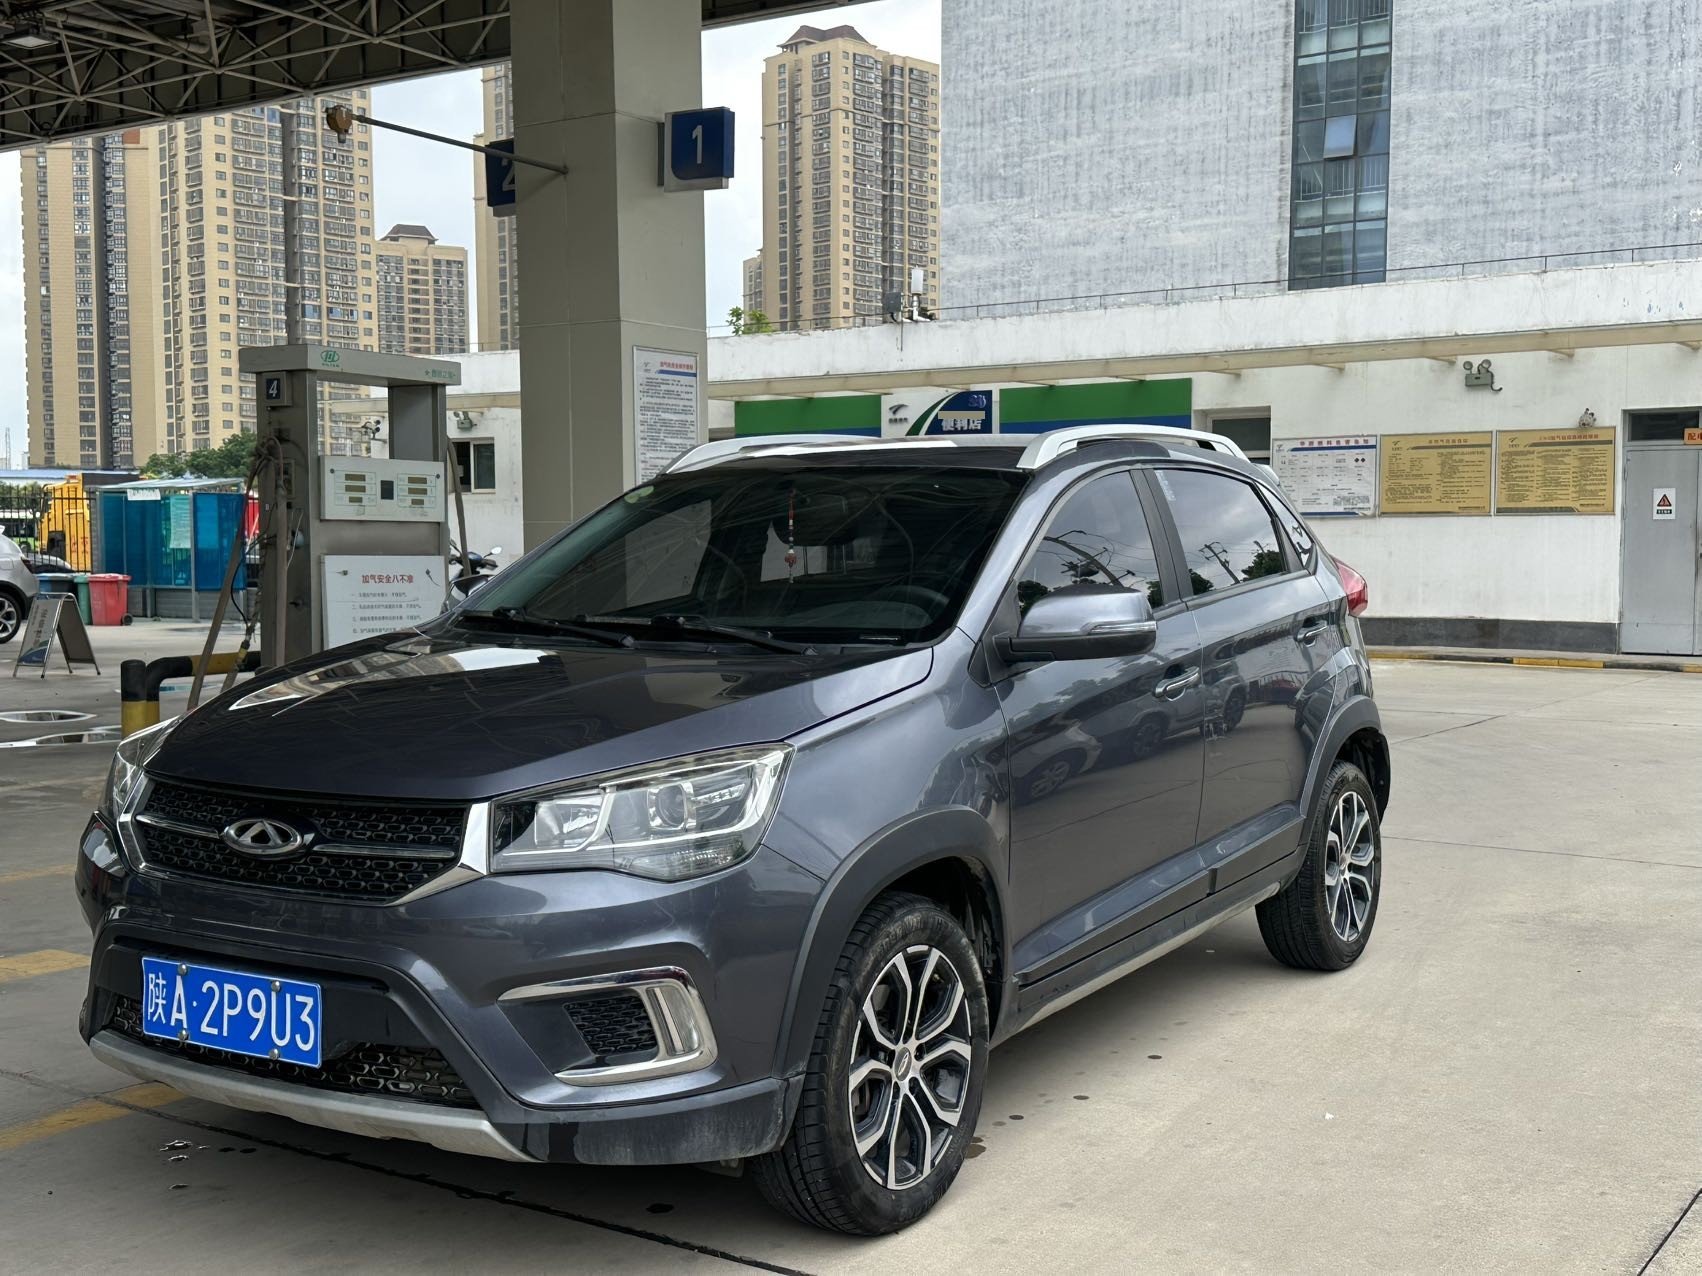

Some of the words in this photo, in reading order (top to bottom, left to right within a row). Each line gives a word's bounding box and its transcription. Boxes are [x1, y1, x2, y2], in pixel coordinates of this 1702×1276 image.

[691, 124, 703, 164] 1
[268, 379, 278, 397] 4
[941, 418, 982, 431] 便利店
[148, 972, 316, 1052] 陕A·2P9U3
